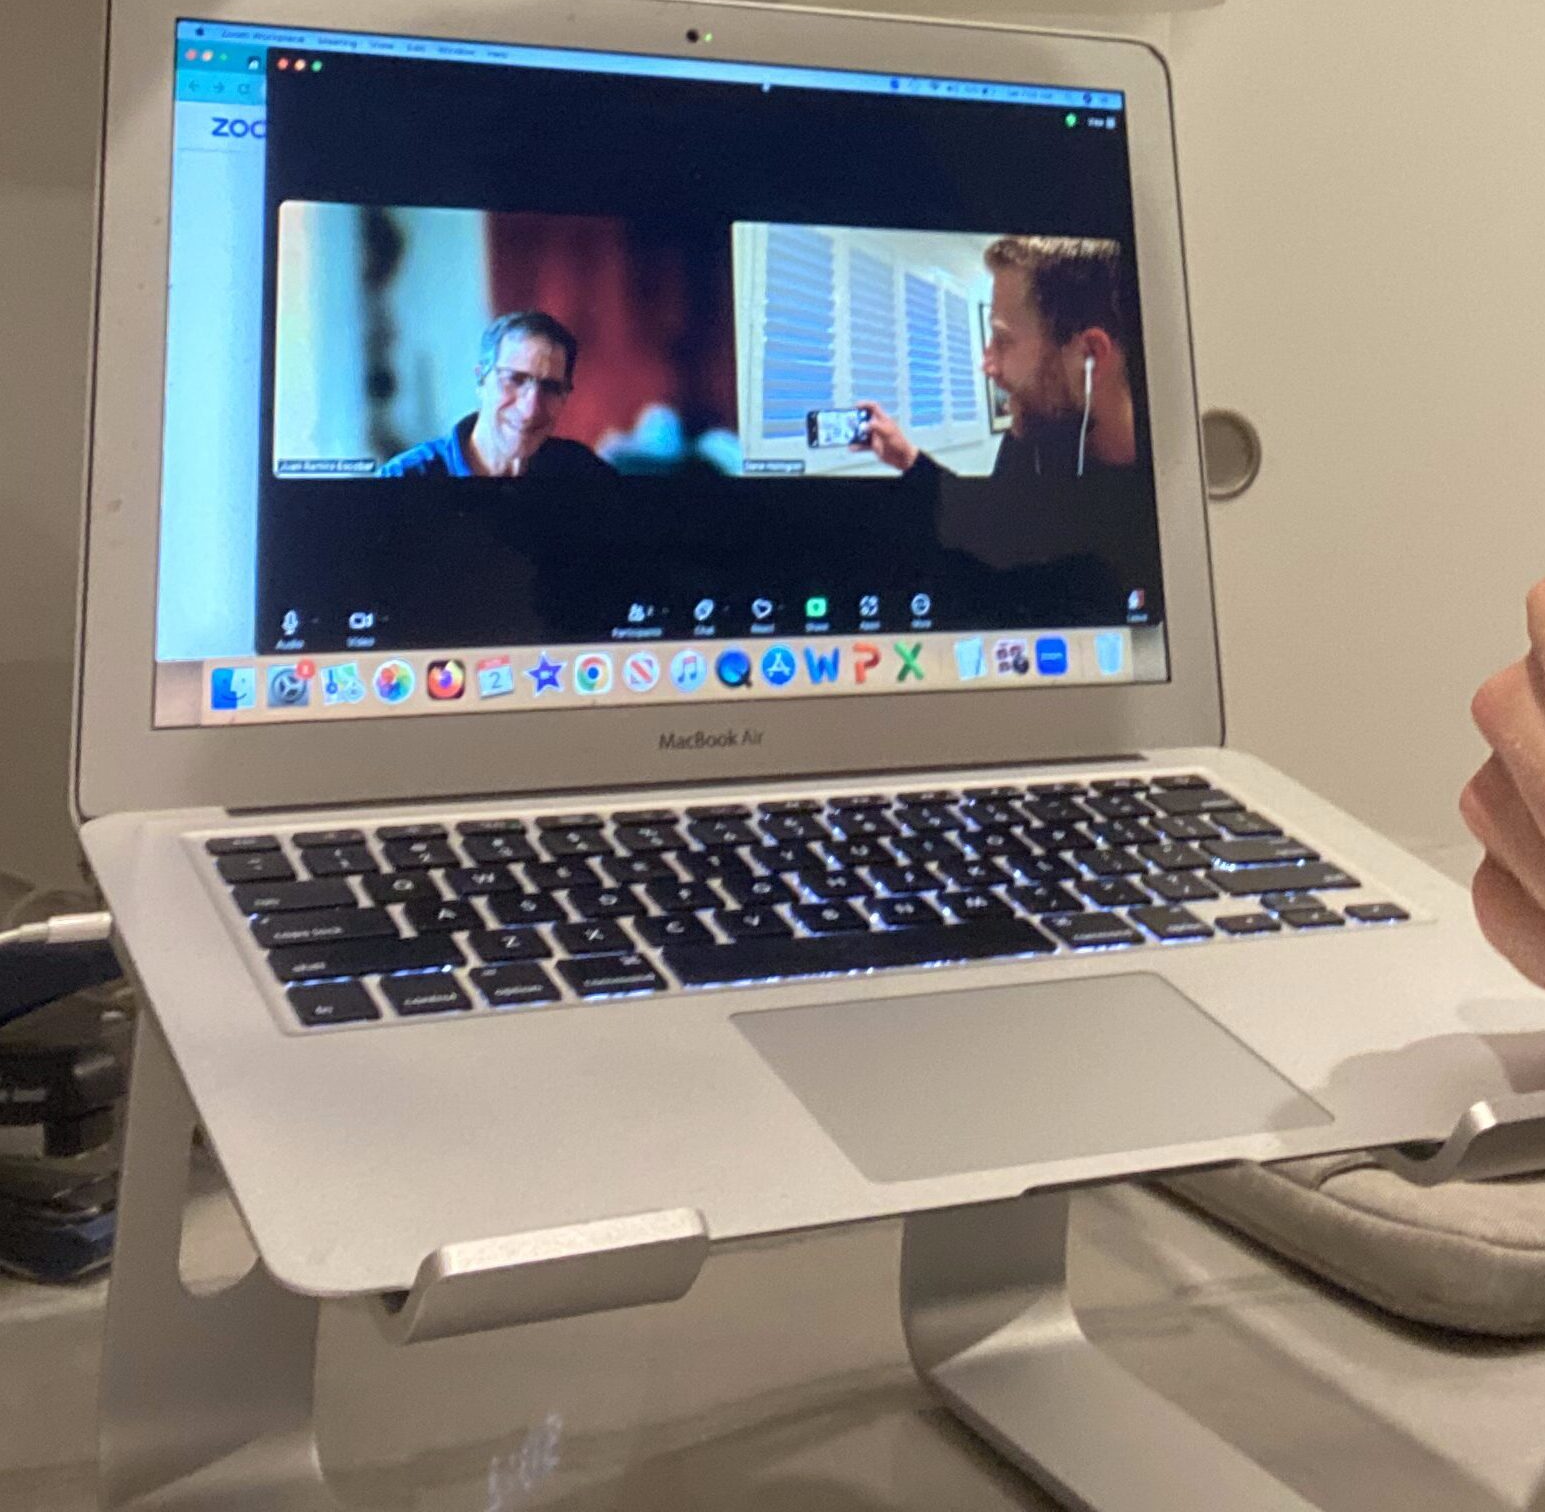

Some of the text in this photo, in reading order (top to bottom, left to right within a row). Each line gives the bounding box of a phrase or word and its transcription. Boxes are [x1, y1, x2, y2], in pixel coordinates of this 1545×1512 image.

[488, 671, 503, 690] 2
[803, 645, 840, 685] W
[852, 642, 882, 685] P
[894, 640, 925, 683] X
[659, 729, 764, 749] MacBook Air
